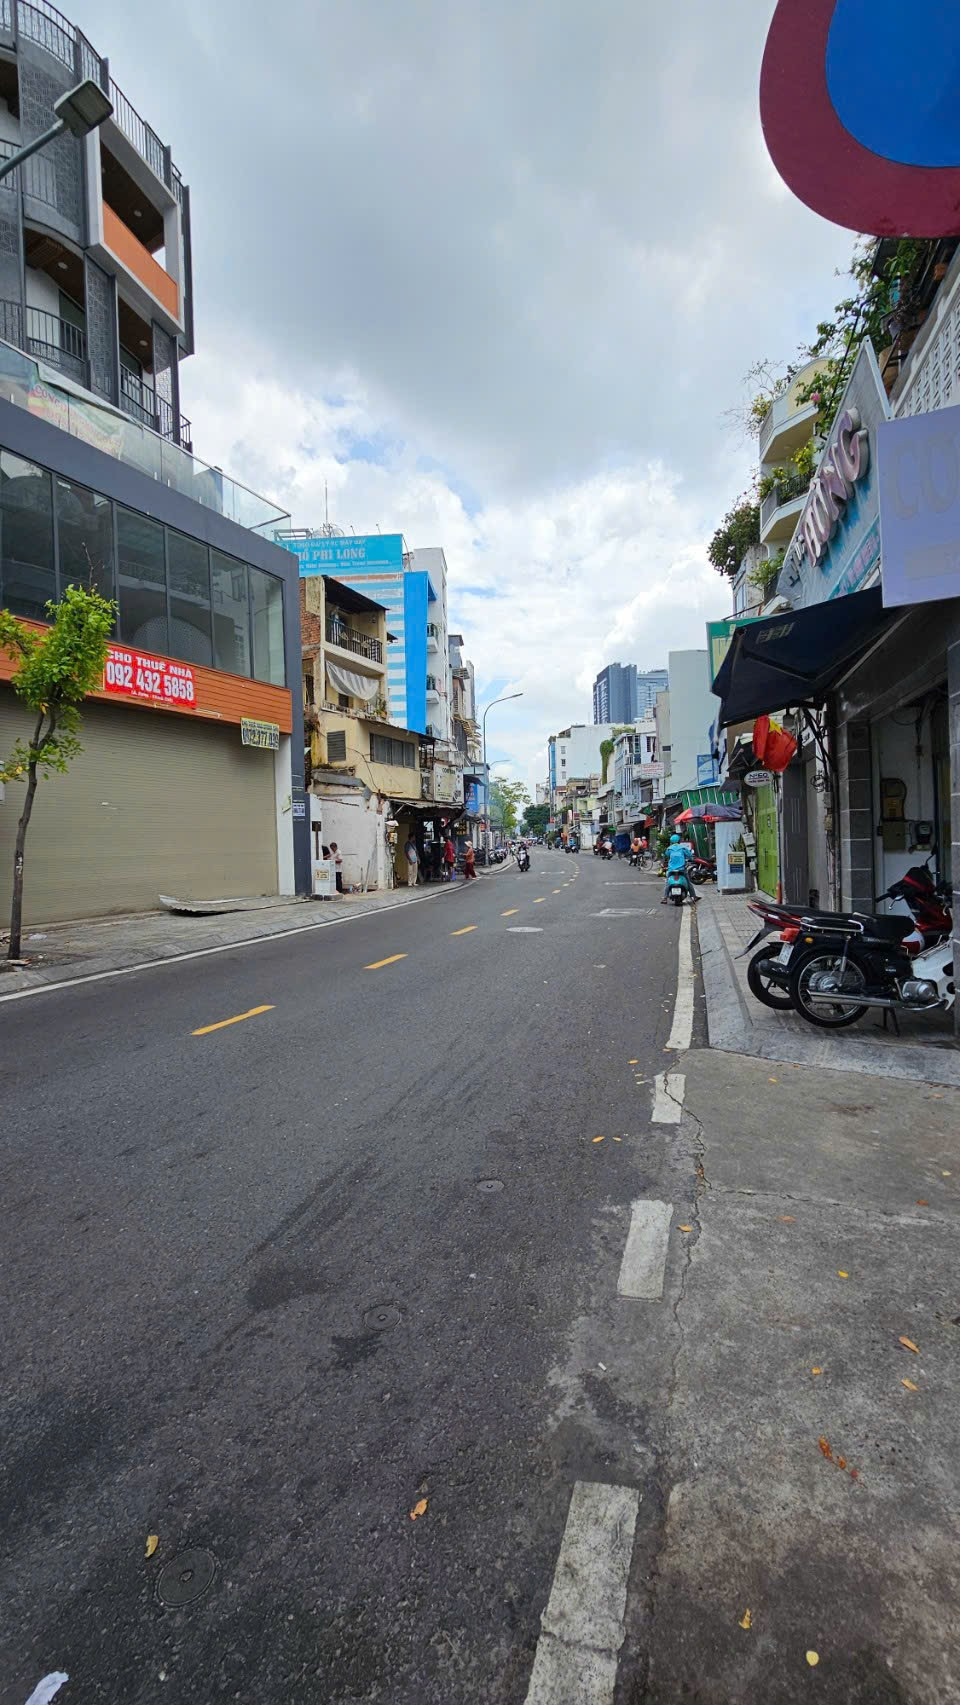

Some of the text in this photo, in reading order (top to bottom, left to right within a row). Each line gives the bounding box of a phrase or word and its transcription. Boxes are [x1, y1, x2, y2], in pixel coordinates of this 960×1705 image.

[337, 547, 366, 560] LONG
[107, 650, 132, 663] CHO
[106, 661, 133, 688] 092
[136, 668, 161, 694] 432
[164, 674, 194, 701] 5858
